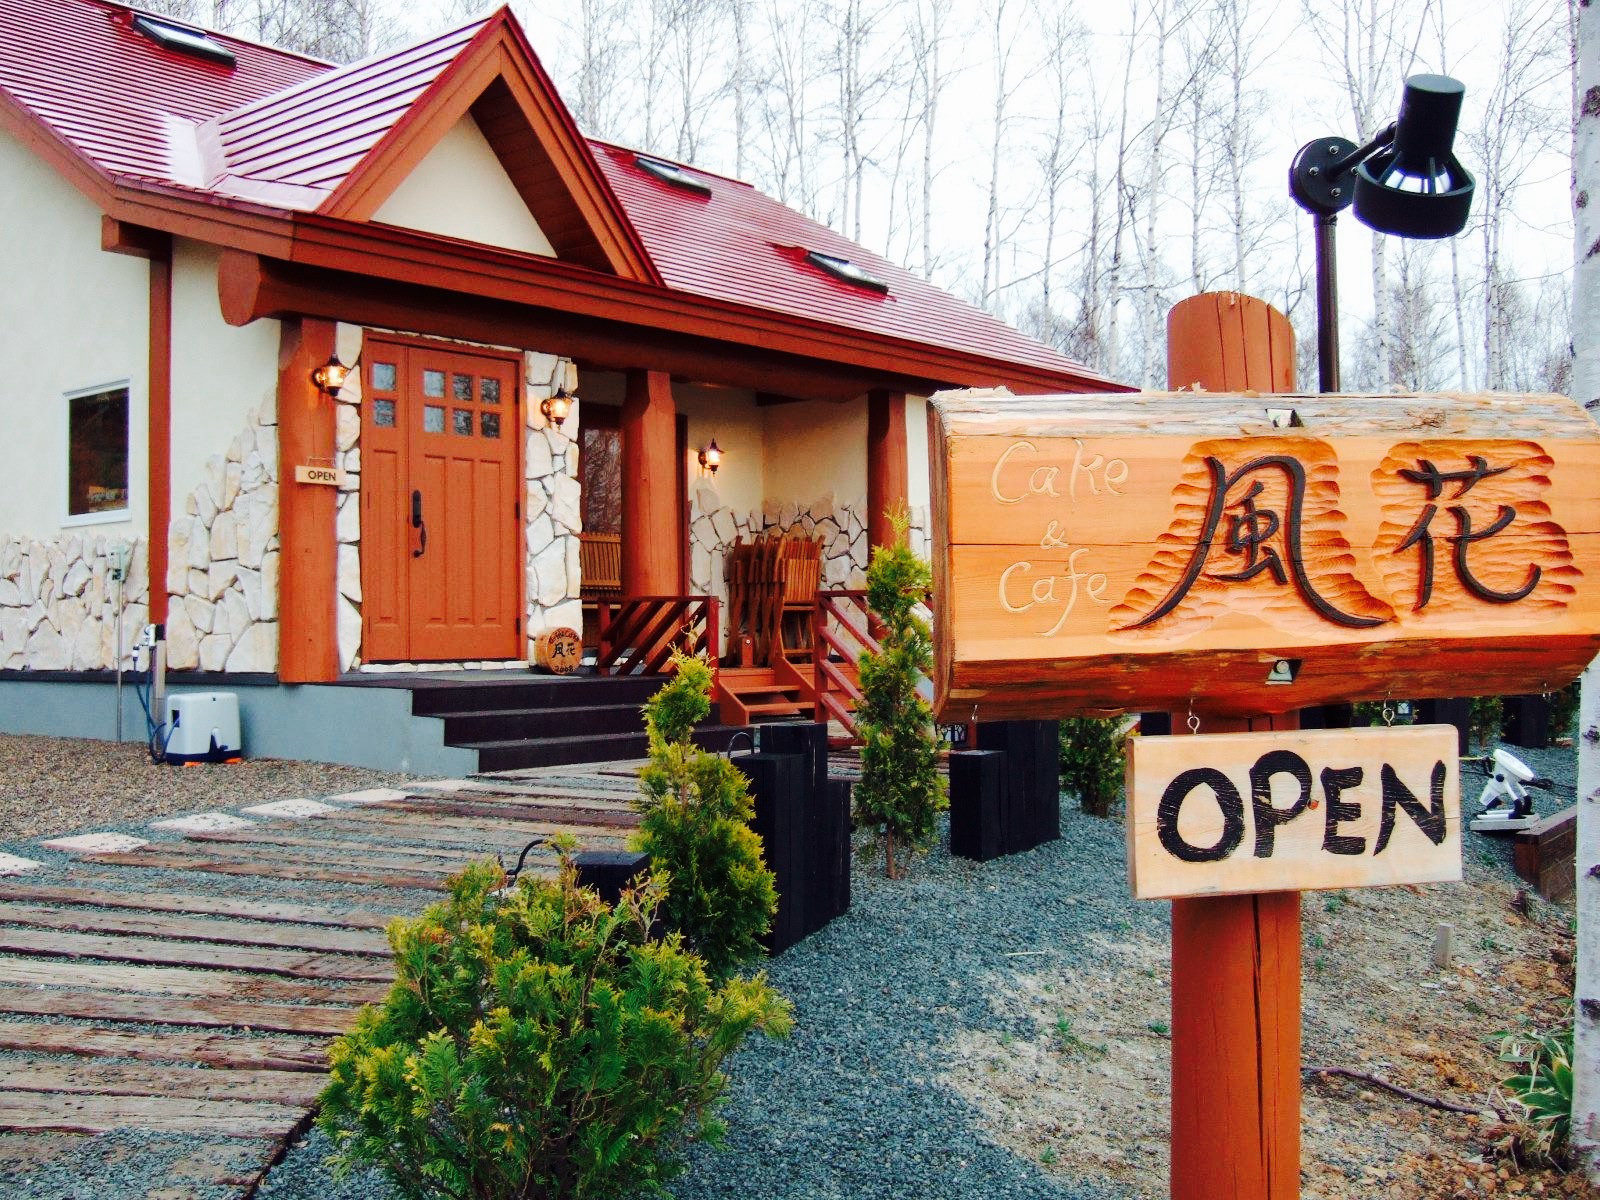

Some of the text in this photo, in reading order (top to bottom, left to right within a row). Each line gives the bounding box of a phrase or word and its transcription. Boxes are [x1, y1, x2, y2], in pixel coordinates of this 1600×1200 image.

[308, 470, 336, 481] OPEN
[992, 437, 1129, 504] Cake
[1041, 520, 1069, 549] &
[1113, 454, 1542, 630] 風花
[1000, 548, 1112, 637] Cafe
[1156, 750, 1447, 863] OPEN
